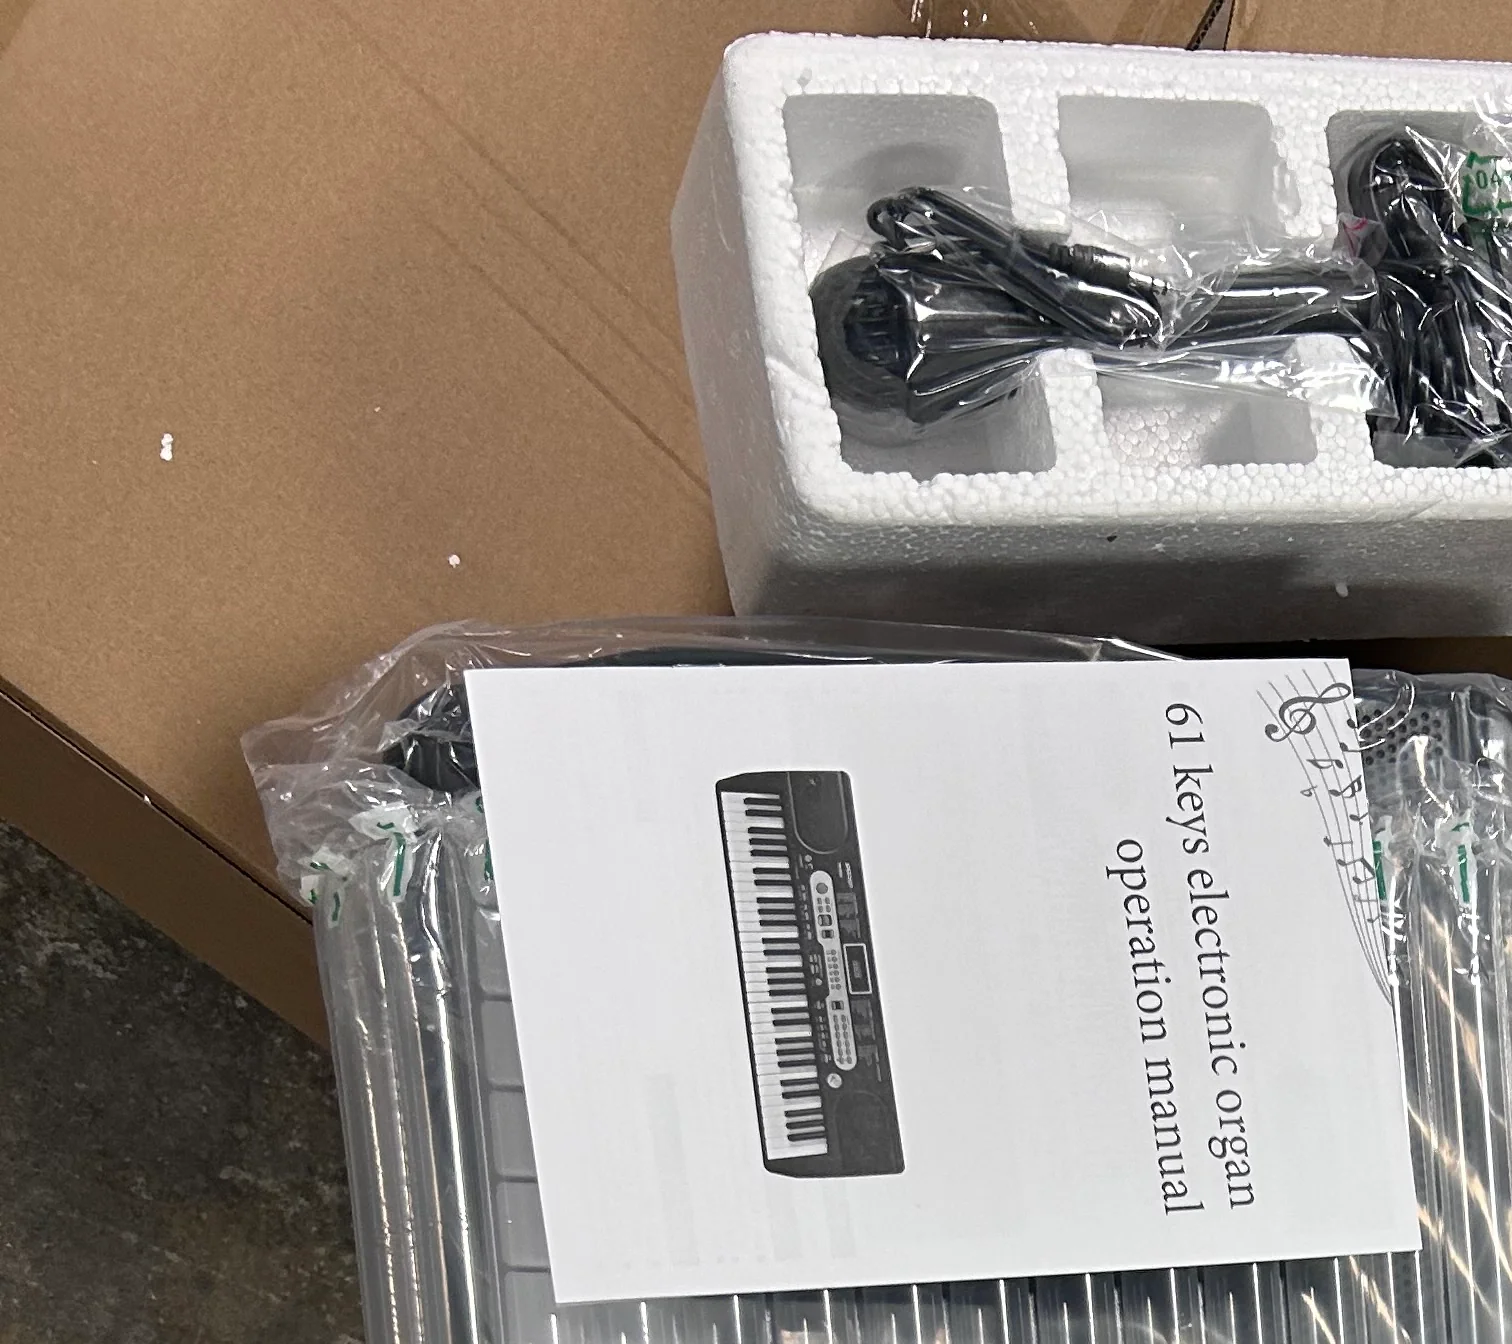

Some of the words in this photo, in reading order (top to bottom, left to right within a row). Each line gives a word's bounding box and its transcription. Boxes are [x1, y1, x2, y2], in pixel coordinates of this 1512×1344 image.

[1165, 703, 1204, 749] 61
[1165, 762, 1214, 855] keys
[1106, 838, 1172, 1045] operation
[1144, 1059, 1204, 1214] manual
[1186, 866, 1246, 1076] electronic
[1208, 1088, 1256, 1208] organ
